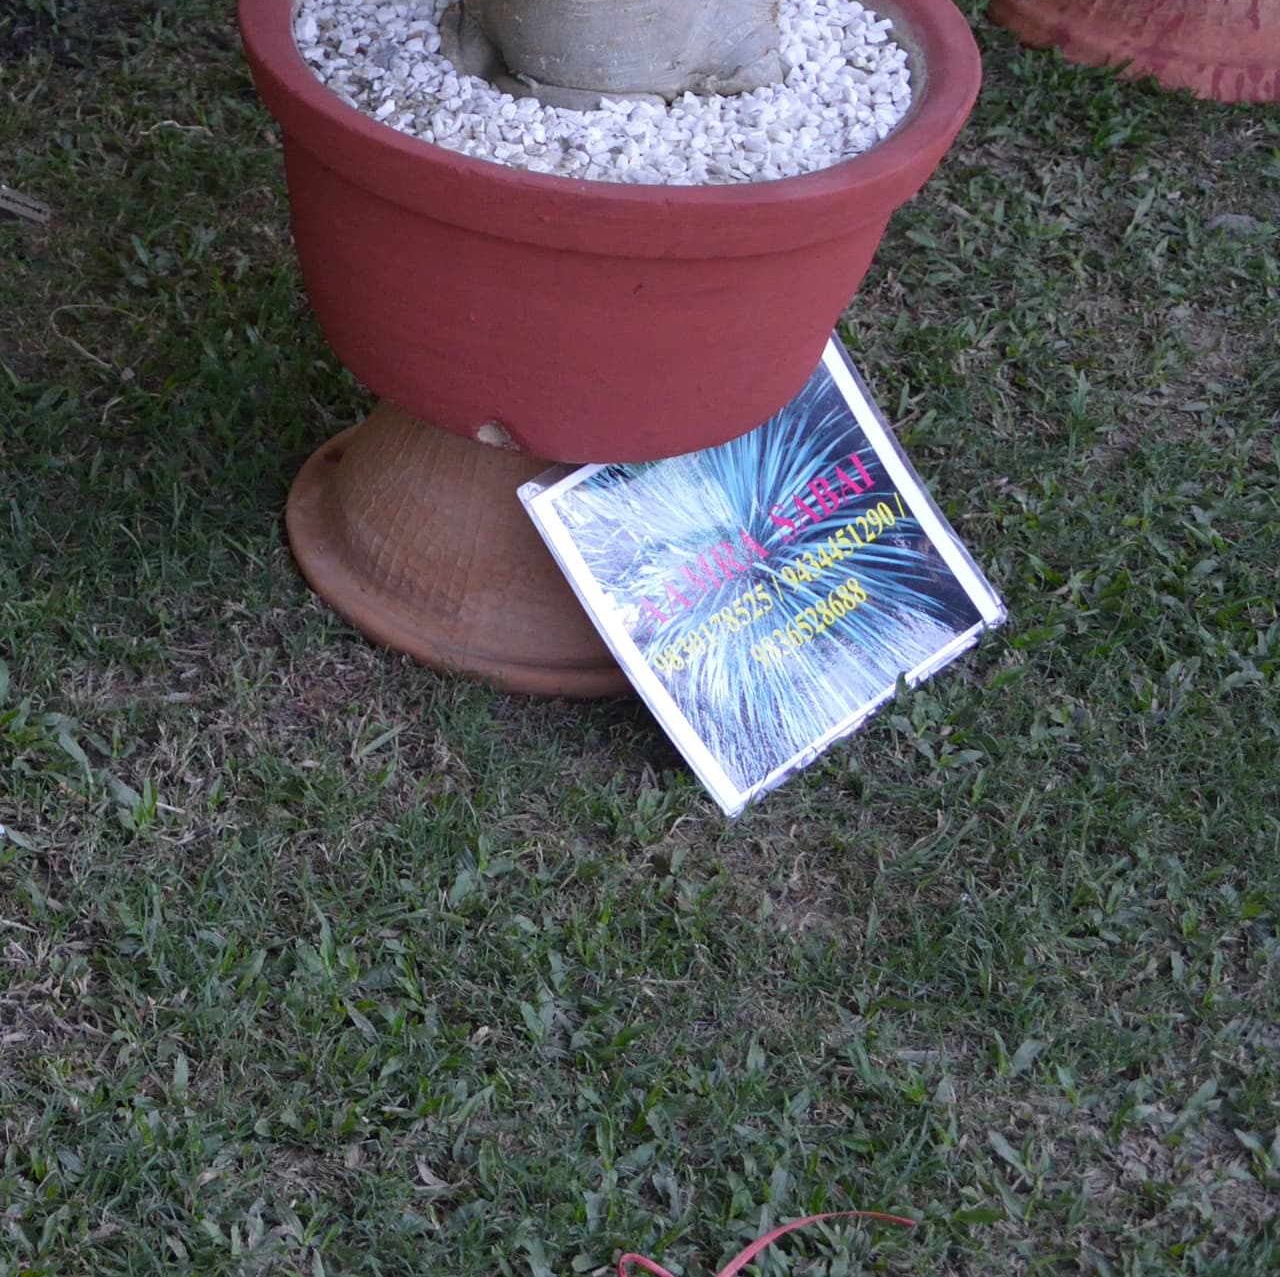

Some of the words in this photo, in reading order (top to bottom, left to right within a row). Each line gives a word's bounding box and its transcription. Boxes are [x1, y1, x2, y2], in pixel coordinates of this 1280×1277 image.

[639, 527, 771, 630] AAMRA
[769, 451, 876, 544] SABAI
[653, 581, 775, 672] 9830178525
[780, 501, 897, 594] 9434451290
[750, 577, 868, 667] 9836528688
